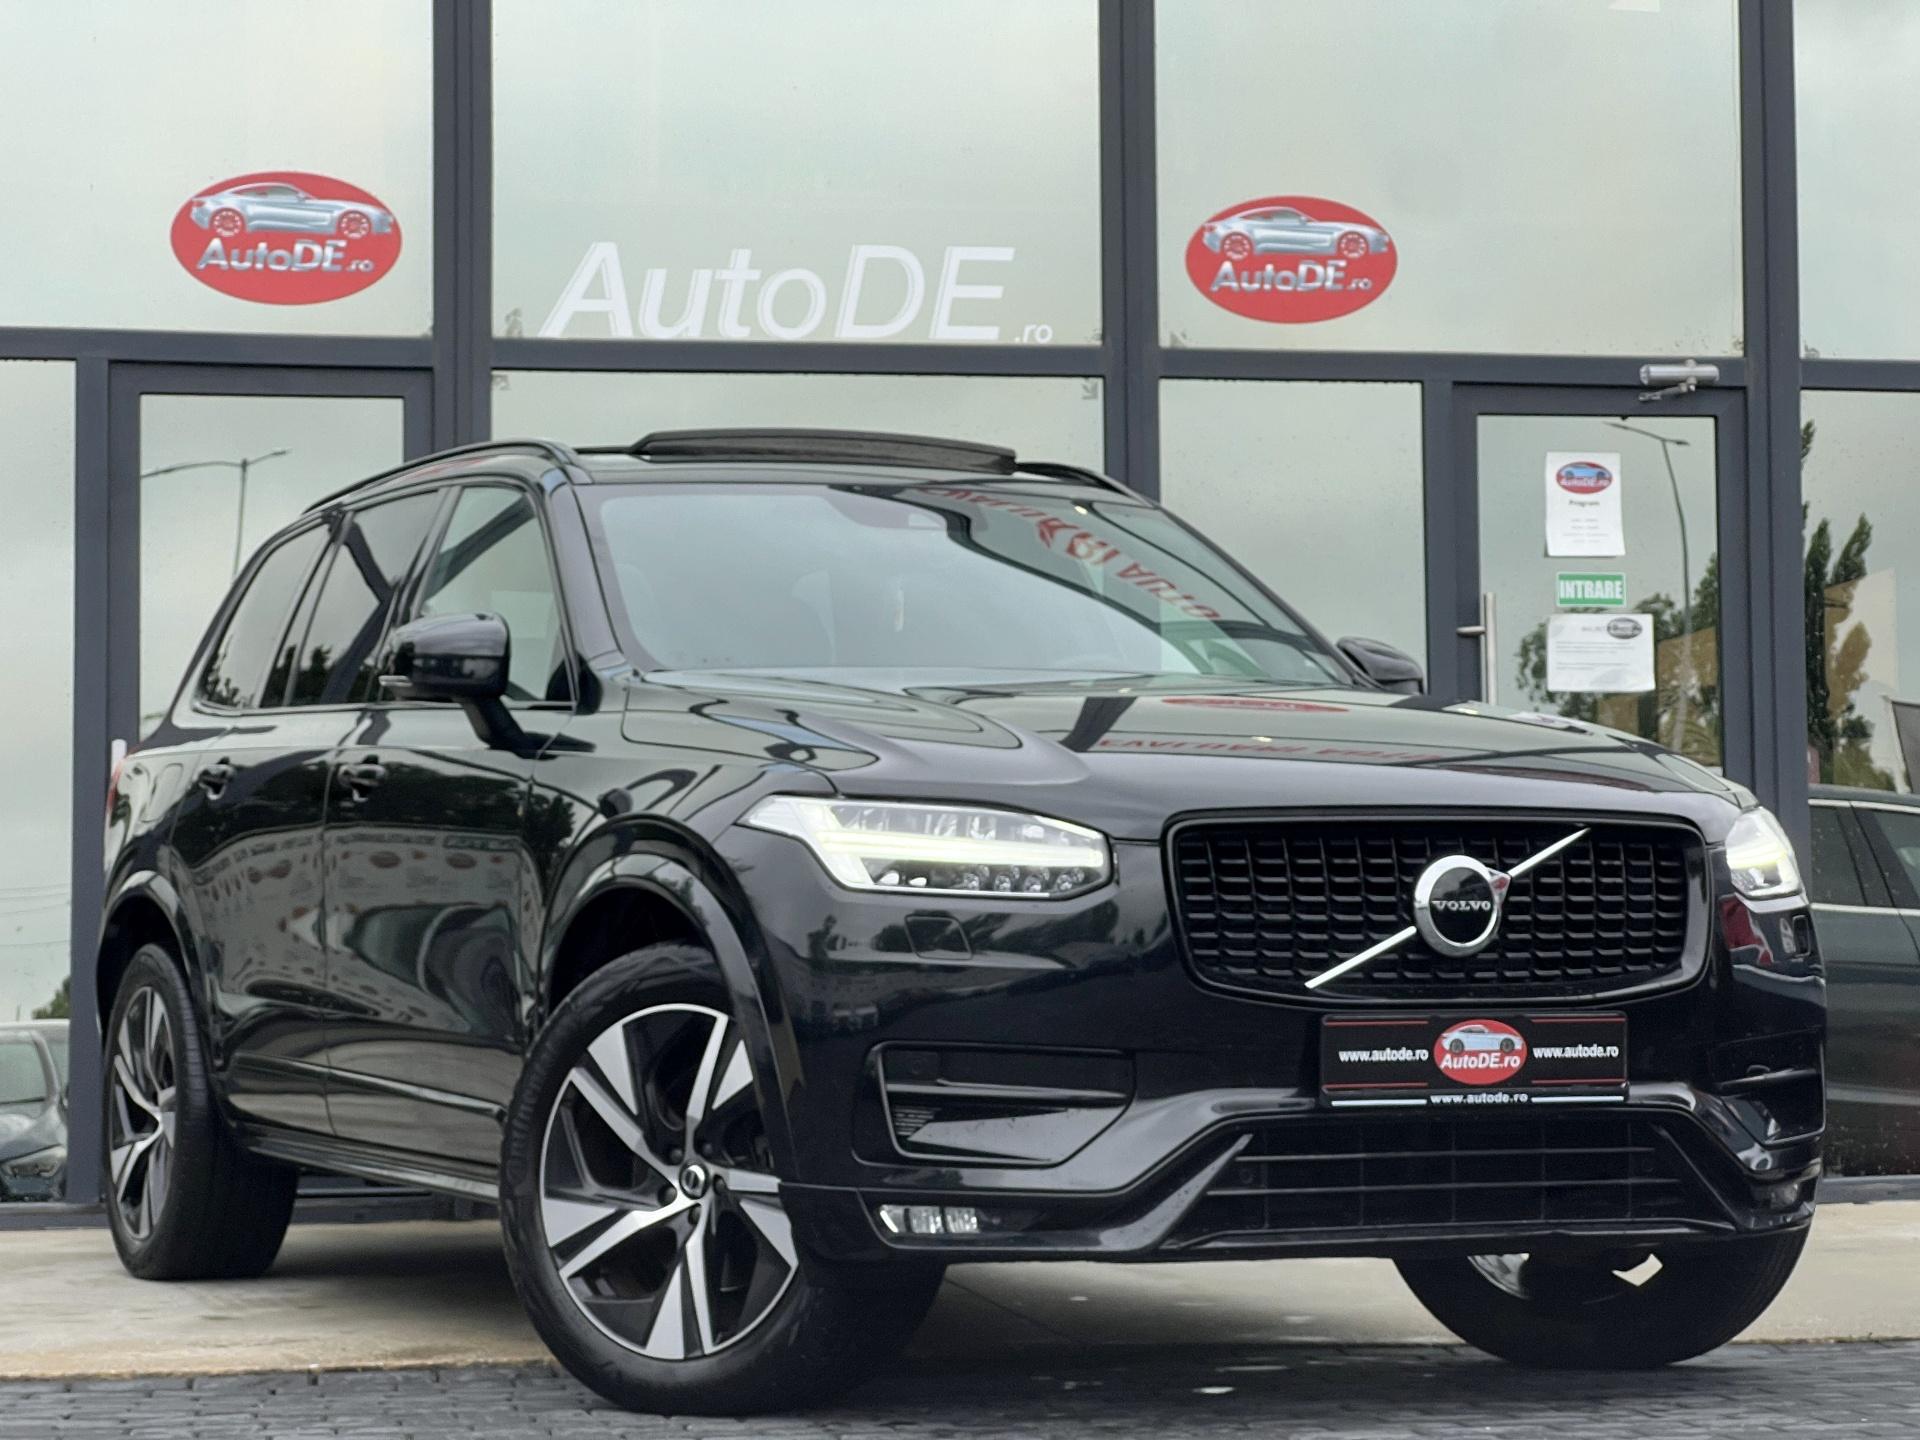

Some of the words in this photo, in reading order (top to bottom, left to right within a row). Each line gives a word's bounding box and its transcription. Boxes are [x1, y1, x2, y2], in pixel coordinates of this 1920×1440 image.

[1559, 579, 1623, 599] INTRARE
[1431, 900, 1492, 911] VOLVO
[1338, 1046, 1429, 1062] www.autode.ro
[1532, 1043, 1620, 1059] www.autode.ro
[1440, 1052, 1521, 1069] AutoDE.ro
[1430, 1091, 1529, 1104] www.autode.ro
